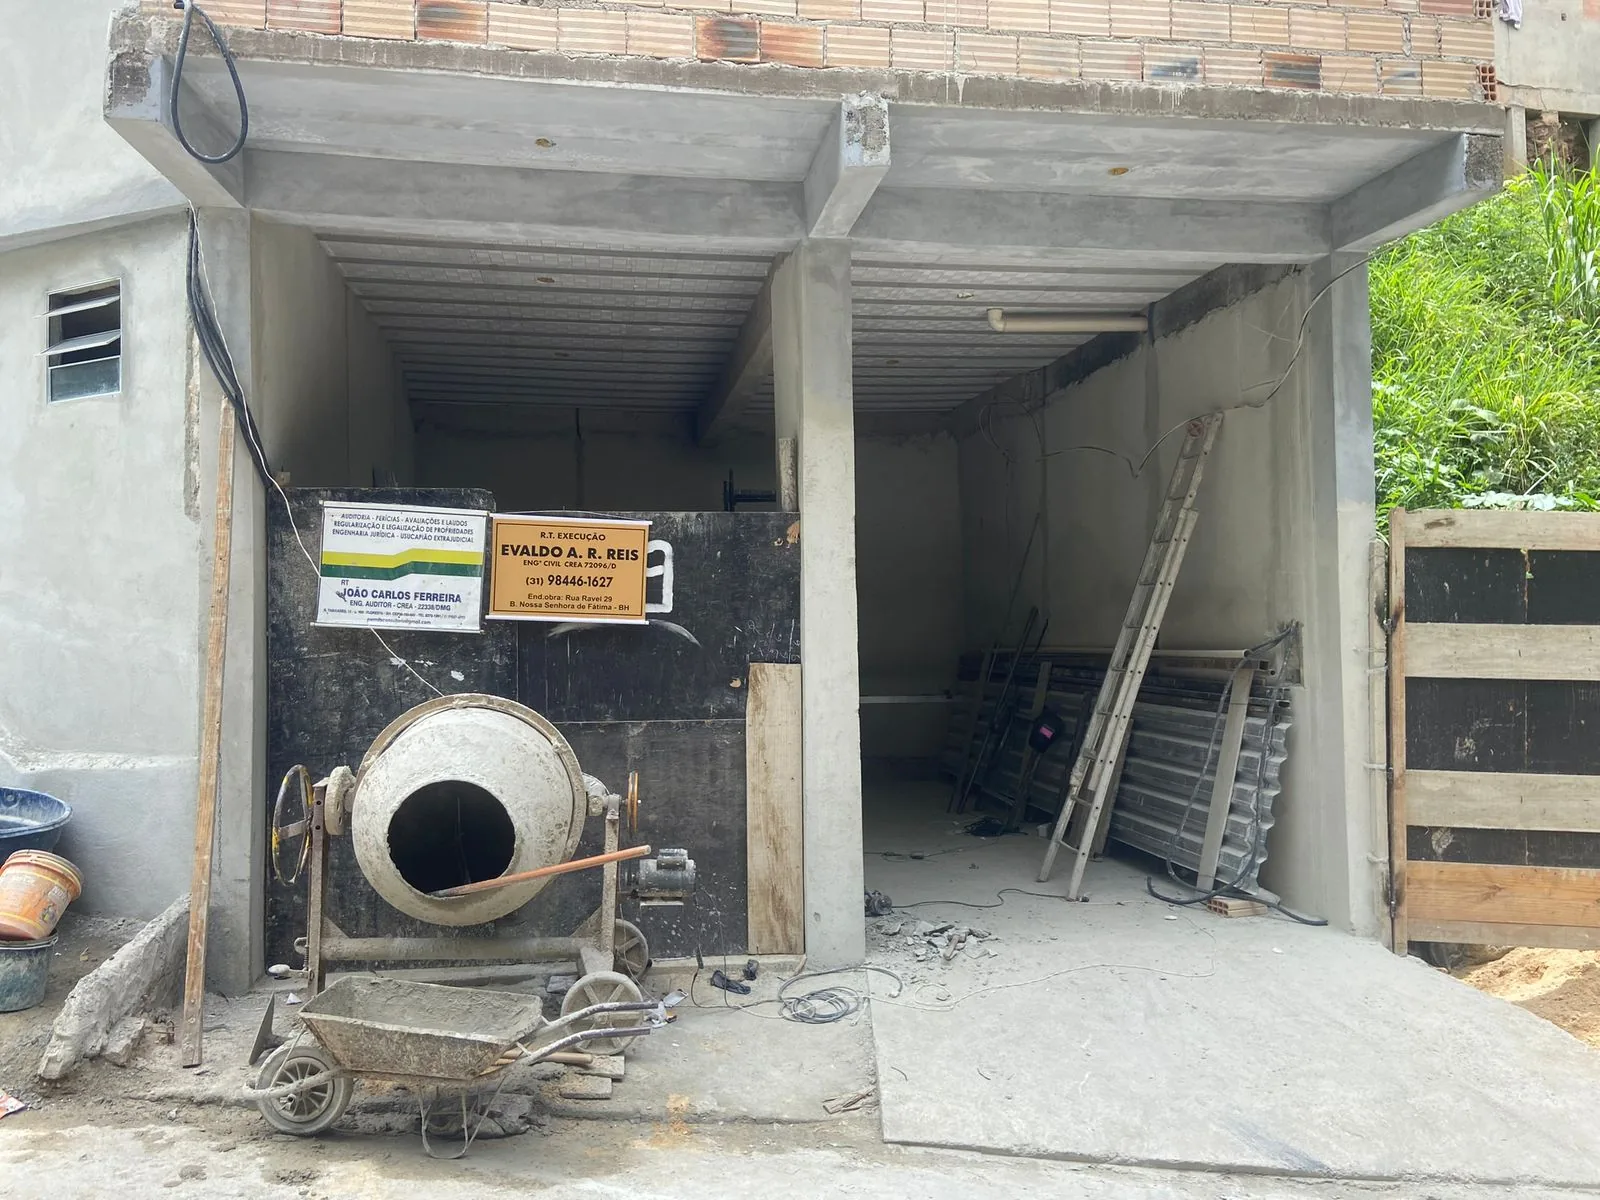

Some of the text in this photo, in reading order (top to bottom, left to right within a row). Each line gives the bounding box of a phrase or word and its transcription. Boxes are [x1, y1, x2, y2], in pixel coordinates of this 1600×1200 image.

[405, 516, 440, 525] AVALIAÇÕES
[334, 520, 380, 530] REGULARIZAÇÃO
[386, 523, 424, 532] LEGALIZAÇÃO
[434, 526, 474, 535] PROPRIEDADES
[400, 532, 432, 541] USUCAPIÃO
[434, 535, 474, 543] EXTRAJUDICIAL
[558, 532, 606, 542] EXECUÇÃO
[501, 544, 639, 560] EVALDO A. R. REIS
[526, 575, 613, 587] (31) 98446-1627
[342, 586, 462, 603] JOÃO CARLOS FERREIRA
